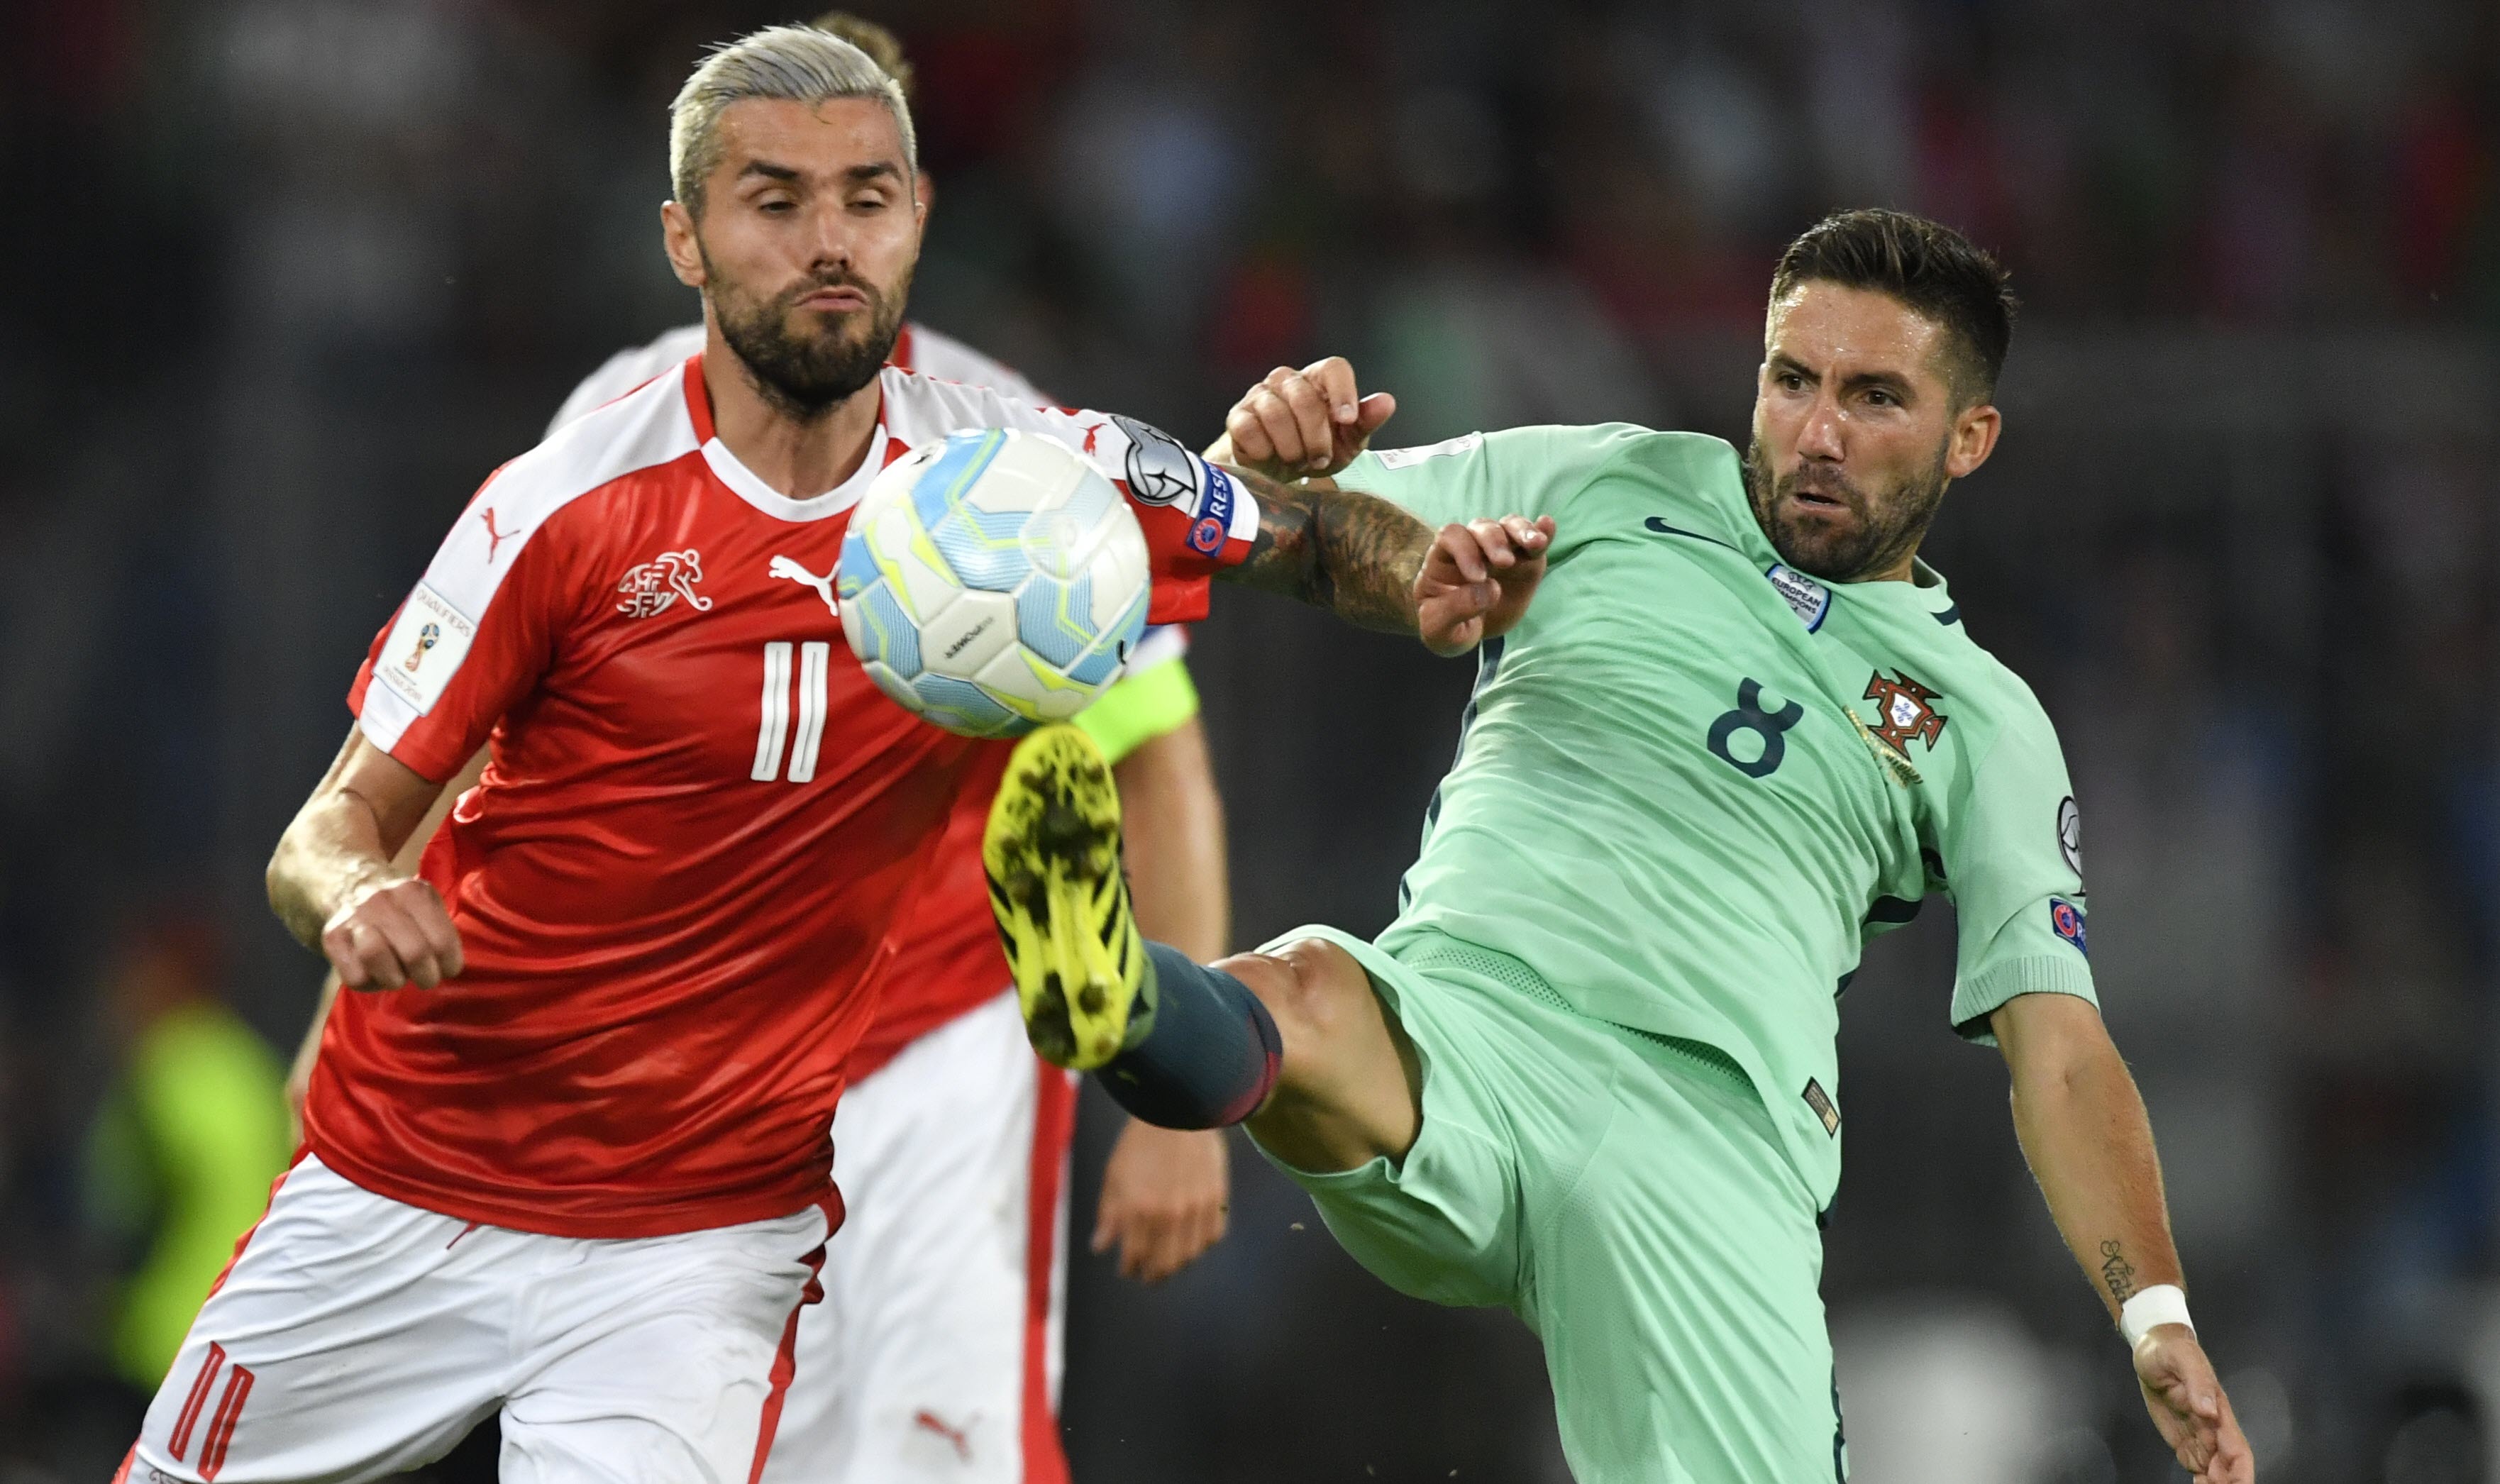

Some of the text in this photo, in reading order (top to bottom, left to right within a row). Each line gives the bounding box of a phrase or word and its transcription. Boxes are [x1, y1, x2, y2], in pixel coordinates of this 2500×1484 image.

[1771, 577, 1822, 607] EUROPEAN
[1778, 589, 1817, 614] AMPIONS
[750, 641, 830, 782] 11
[1708, 677, 1804, 778] 8
[167, 1340, 255, 1482] 11
